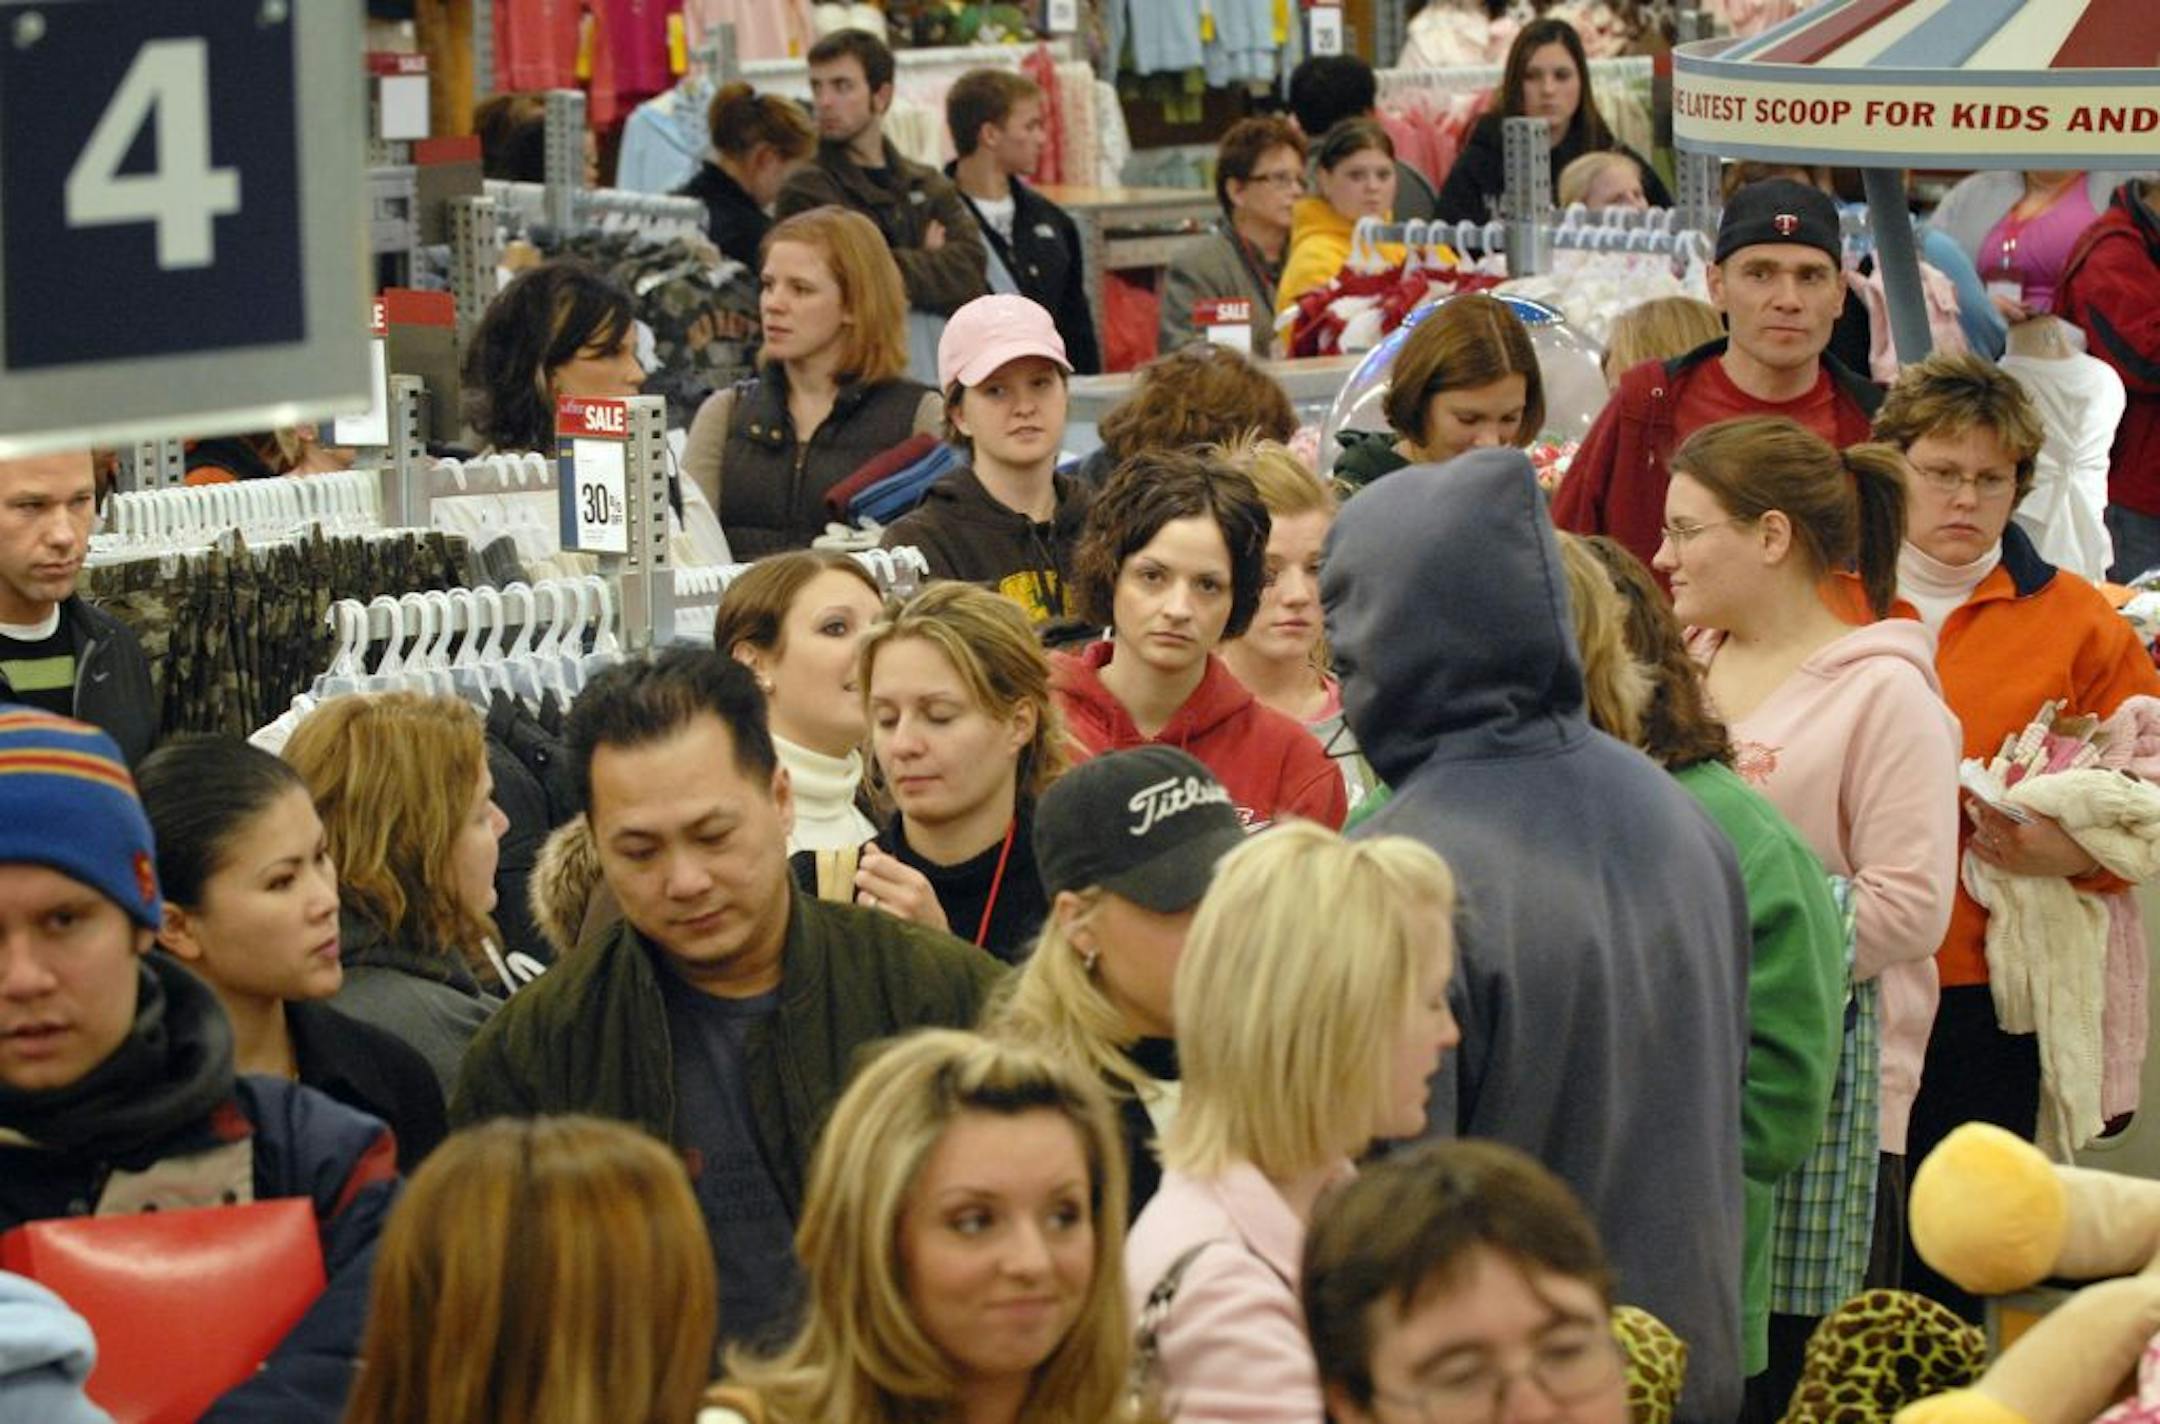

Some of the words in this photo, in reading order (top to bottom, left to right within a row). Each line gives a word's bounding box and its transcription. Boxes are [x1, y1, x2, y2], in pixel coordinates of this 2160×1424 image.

[1687, 92, 1747, 122] LATEST
[1754, 98, 1853, 126] SCOOP
[1864, 101, 1936, 128] FOR
[1951, 102, 2052, 132] KIDS
[2066, 106, 2160, 134] AND
[65, 37, 241, 270] 4
[1215, 302, 1250, 321] SALE
[584, 405, 624, 432] SALE
[582, 483, 608, 525] 30
